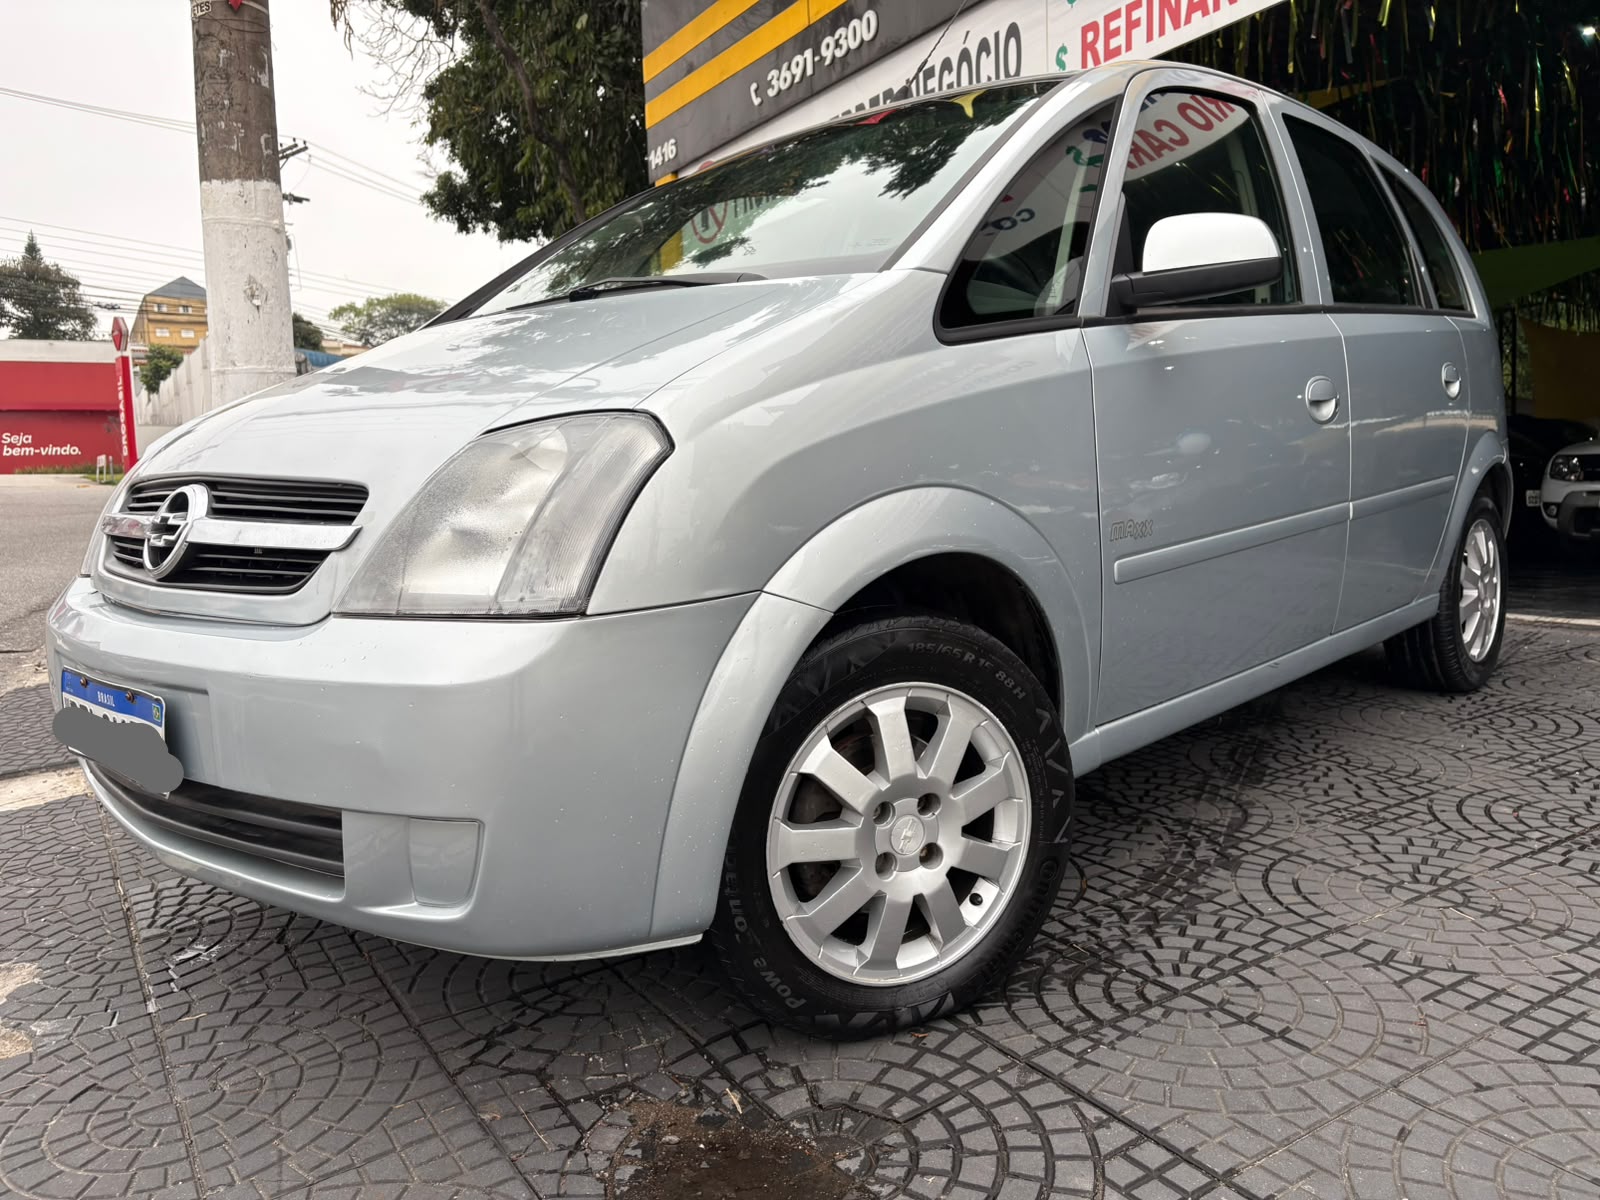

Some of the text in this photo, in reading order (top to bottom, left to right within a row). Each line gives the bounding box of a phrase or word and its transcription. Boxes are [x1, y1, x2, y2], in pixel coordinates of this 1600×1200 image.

[1081, 0, 1238, 69] REFINA
[766, 9, 878, 98] 3691-9300
[649, 138, 677, 170] 1416
[117, 376, 129, 456] DROGASIL
[1, 432, 32, 446] Seja
[3, 444, 81, 456] bem-vindo.
[97, 690, 115, 707] BRASIL
